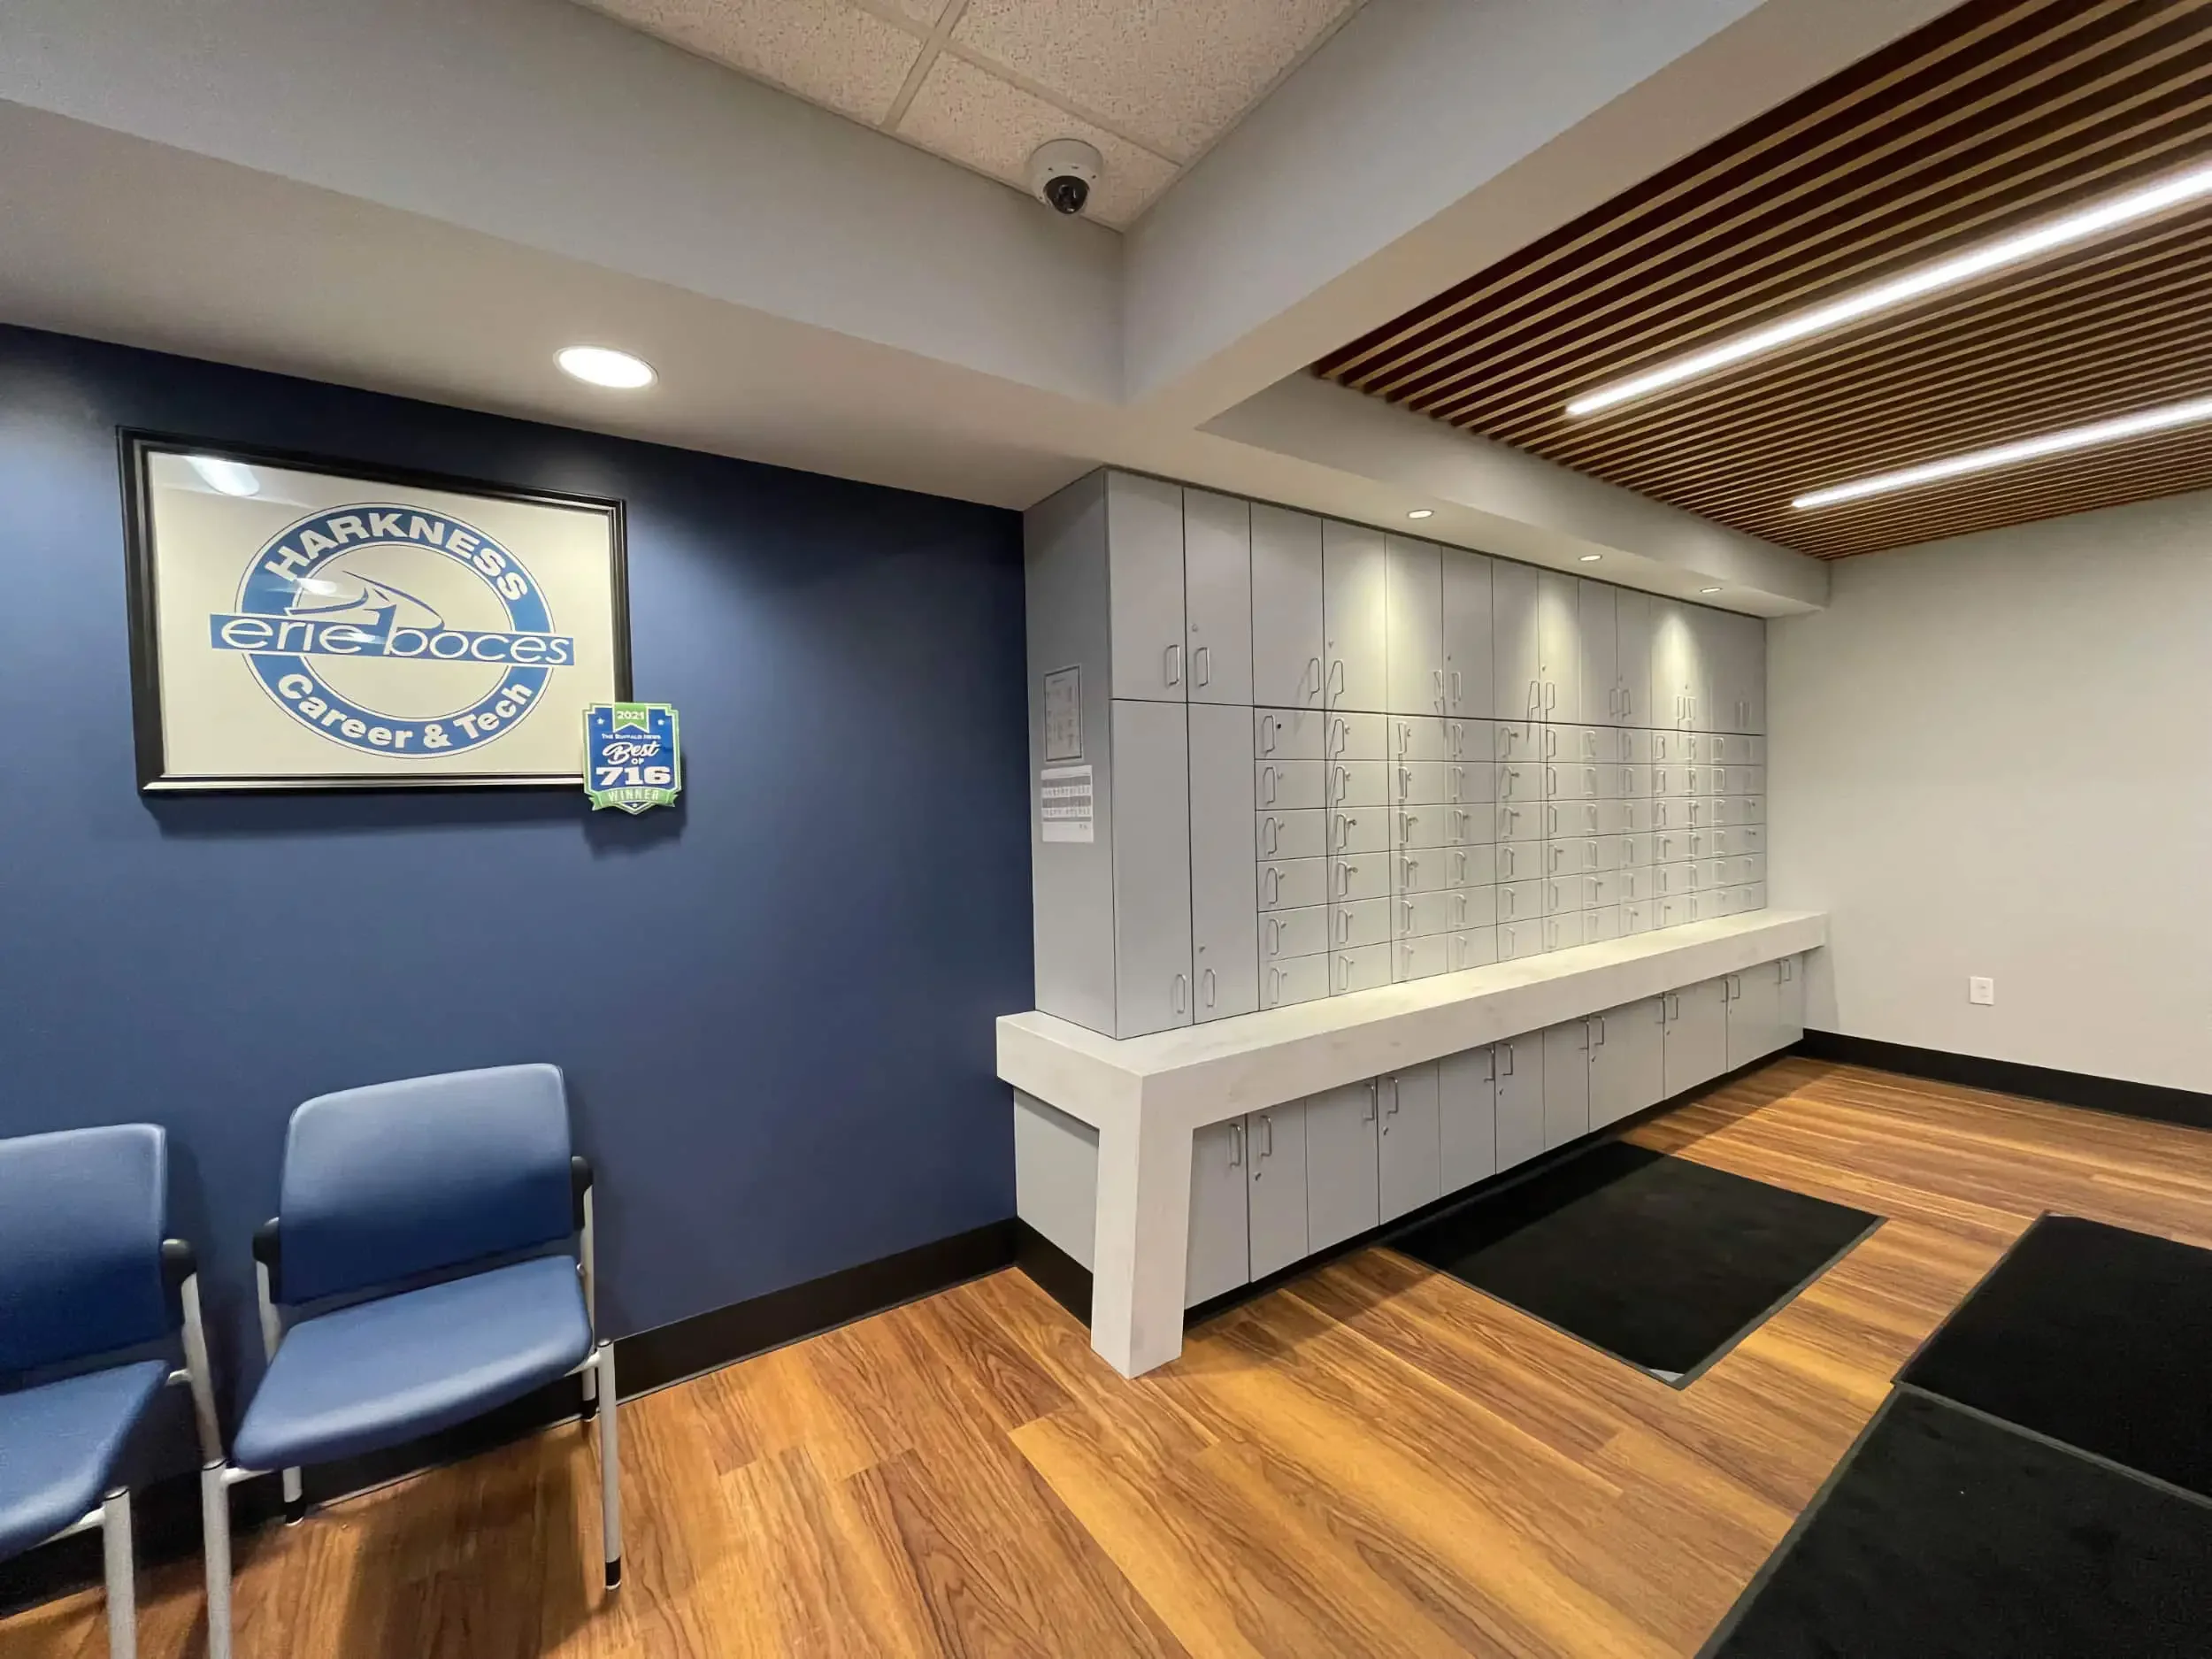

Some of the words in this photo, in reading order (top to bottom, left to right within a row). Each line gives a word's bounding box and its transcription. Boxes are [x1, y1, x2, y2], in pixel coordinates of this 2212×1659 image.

[265, 512, 528, 602] HARKNESS
[220, 615, 362, 654] erie
[386, 604, 568, 664] boces
[277, 672, 413, 749] Career
[423, 726, 452, 749] &
[453, 683, 533, 740] Tech
[617, 710, 644, 720] 2021
[603, 741, 660, 765] Best
[595, 766, 671, 786] 716
[608, 790, 659, 802] WINNER
